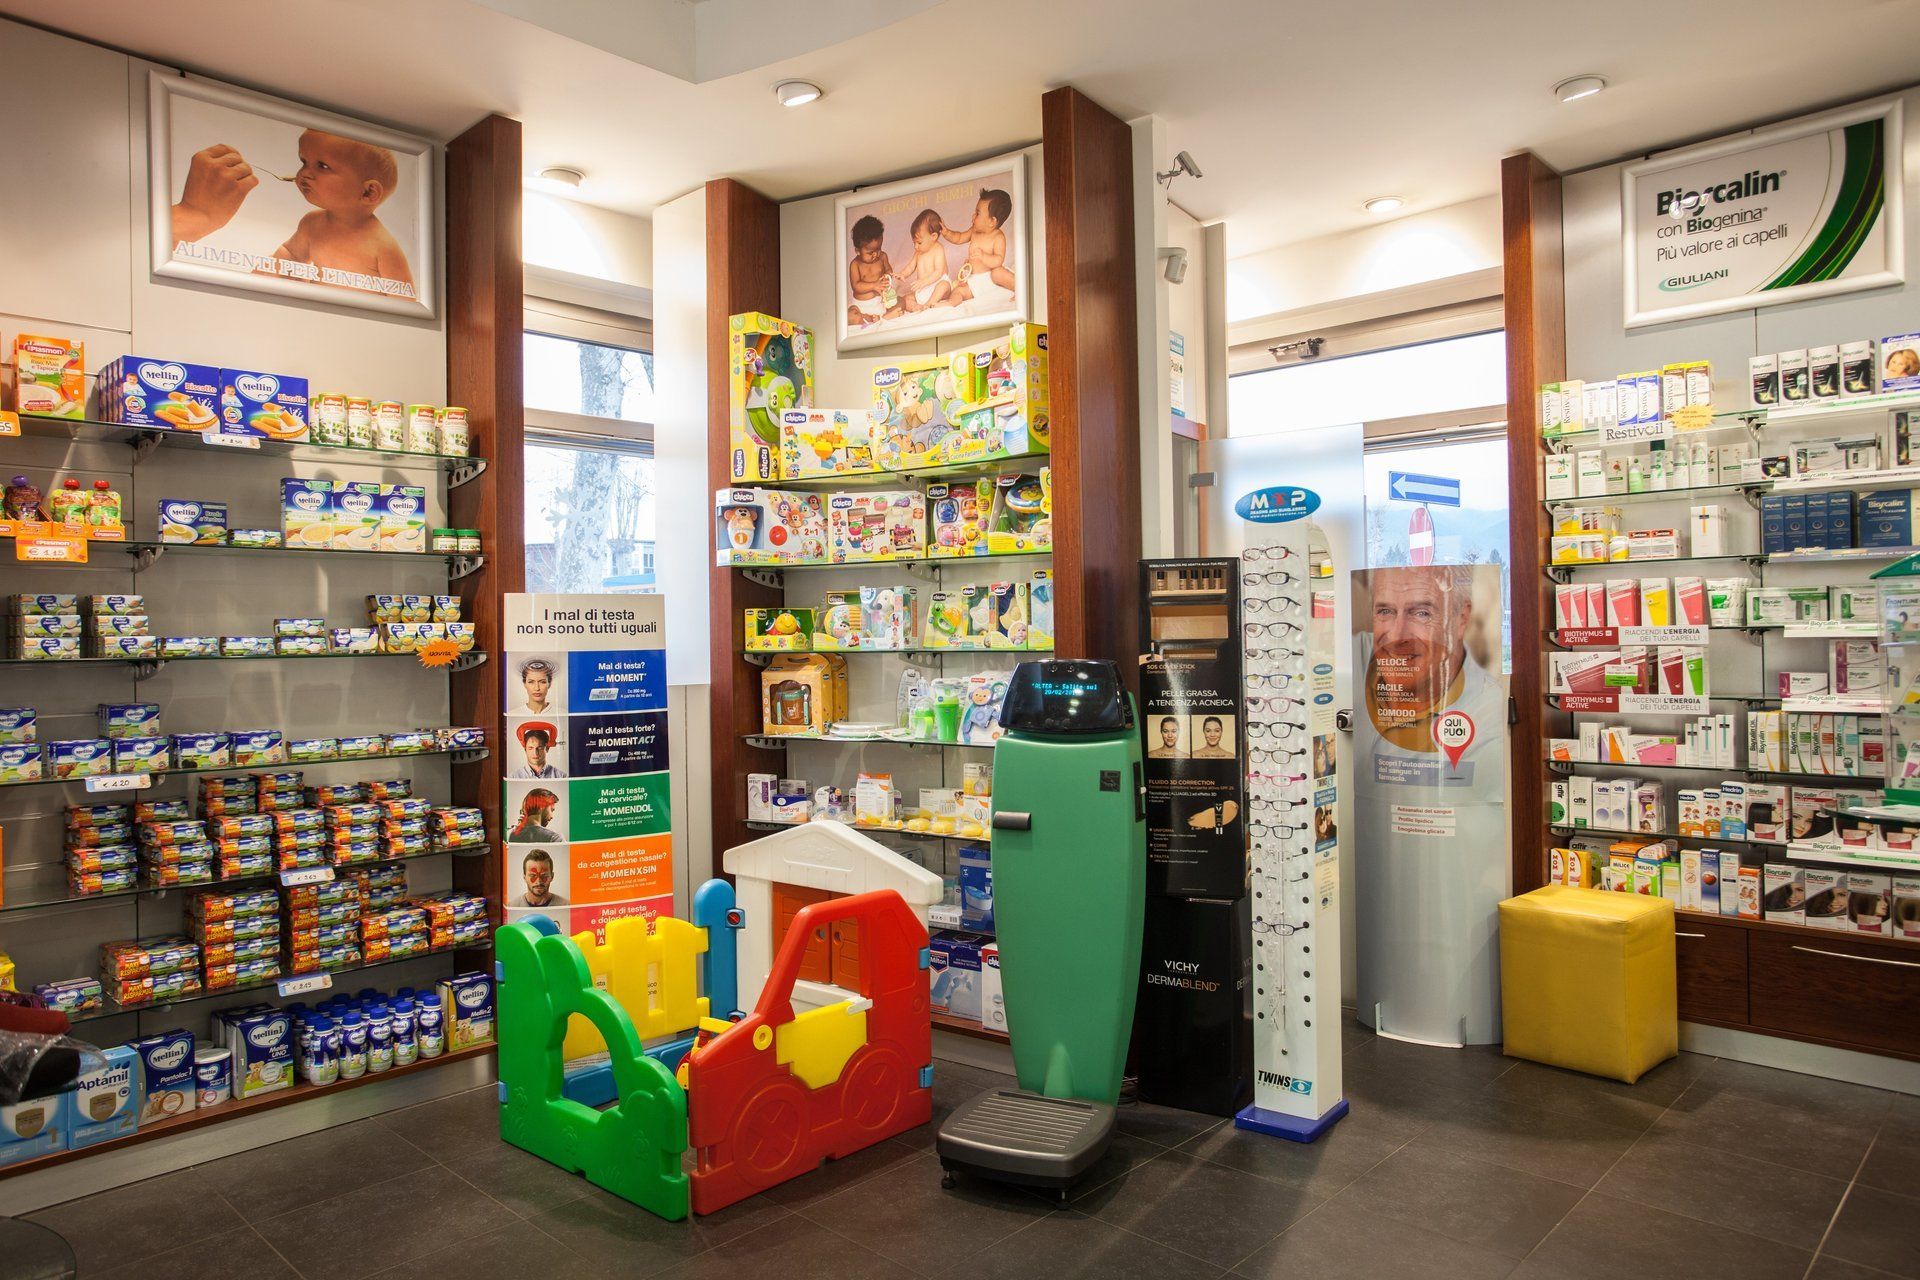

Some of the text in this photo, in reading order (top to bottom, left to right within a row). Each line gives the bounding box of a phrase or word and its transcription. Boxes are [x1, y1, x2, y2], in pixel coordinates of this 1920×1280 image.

[1657, 207, 1762, 238] con Biogenina
[1657, 223, 1788, 261] Più valore ai capelli
[176, 240, 416, 297] ALIMENTI PER L'INFANZIA
[1667, 269, 1729, 287] GIULIANI
[146, 371, 179, 381] Mellin
[875, 369, 899, 384] chicco
[184, 382, 217, 394] Biscotto
[242, 382, 272, 392] Mellin
[277, 393, 307, 404] Biscotto
[876, 401, 884, 409] 12
[785, 415, 806, 423] chicco
[1605, 422, 1664, 441] Restivoil
[929, 487, 946, 495] chicco
[734, 493, 754, 501] chicco
[346, 499, 369, 507] Mellin
[392, 501, 414, 510] Mellin
[832, 498, 852, 507] chicco
[172, 508, 196, 516] Mellin
[544, 609, 635, 620] I mal di testa
[517, 621, 657, 636] non sono tutti uguali
[1564, 630, 1604, 638] BIOTHYMUS
[598, 661, 646, 670] Mal di testa?
[1376, 658, 1407, 666] VELOCE
[1561, 655, 1593, 670] BIOTHYMUS
[605, 673, 644, 683] MOMENT
[1376, 683, 1403, 692] FACILE
[1198, 699, 1234, 707] ACNEICA
[1565, 696, 1604, 704] BIOTHYMUS
[1625, 696, 1662, 704] RIACCENDI
[1377, 709, 1416, 717] COMODO
[1444, 719, 1461, 727] QUI
[588, 723, 656, 735] Mal di testa forte?
[1444, 728, 1466, 736] PUOI
[598, 735, 656, 748] MOMENTACT
[1378, 759, 1398, 767] Scopri
[1378, 773, 1407, 782] farmacia.
[601, 788, 616, 796] Mal
[626, 786, 645, 794] testa
[1721, 785, 1742, 794] Hedrin
[609, 793, 648, 803] cervicale?
[603, 803, 653, 816] MOMENDOL
[1397, 826, 1426, 834] Emoglobina
[626, 849, 646, 857] testa
[589, 857, 638, 869] congestione
[639, 852, 667, 863] nasale?
[1612, 861, 1630, 869] MILICE
[600, 865, 657, 879] MOMENXSIN
[601, 905, 647, 916] Mal di testa
[929, 955, 947, 966] Milton
[1164, 959, 1200, 973] VICHY
[1147, 973, 1217, 992] DERMABLEND
[459, 990, 485, 1002] Mellin
[271, 1049, 287, 1057] UNO
[77, 1071, 129, 1092] Aptamil
[1258, 1070, 1291, 1088] TWINS
[119, 1111, 134, 1128] 2
